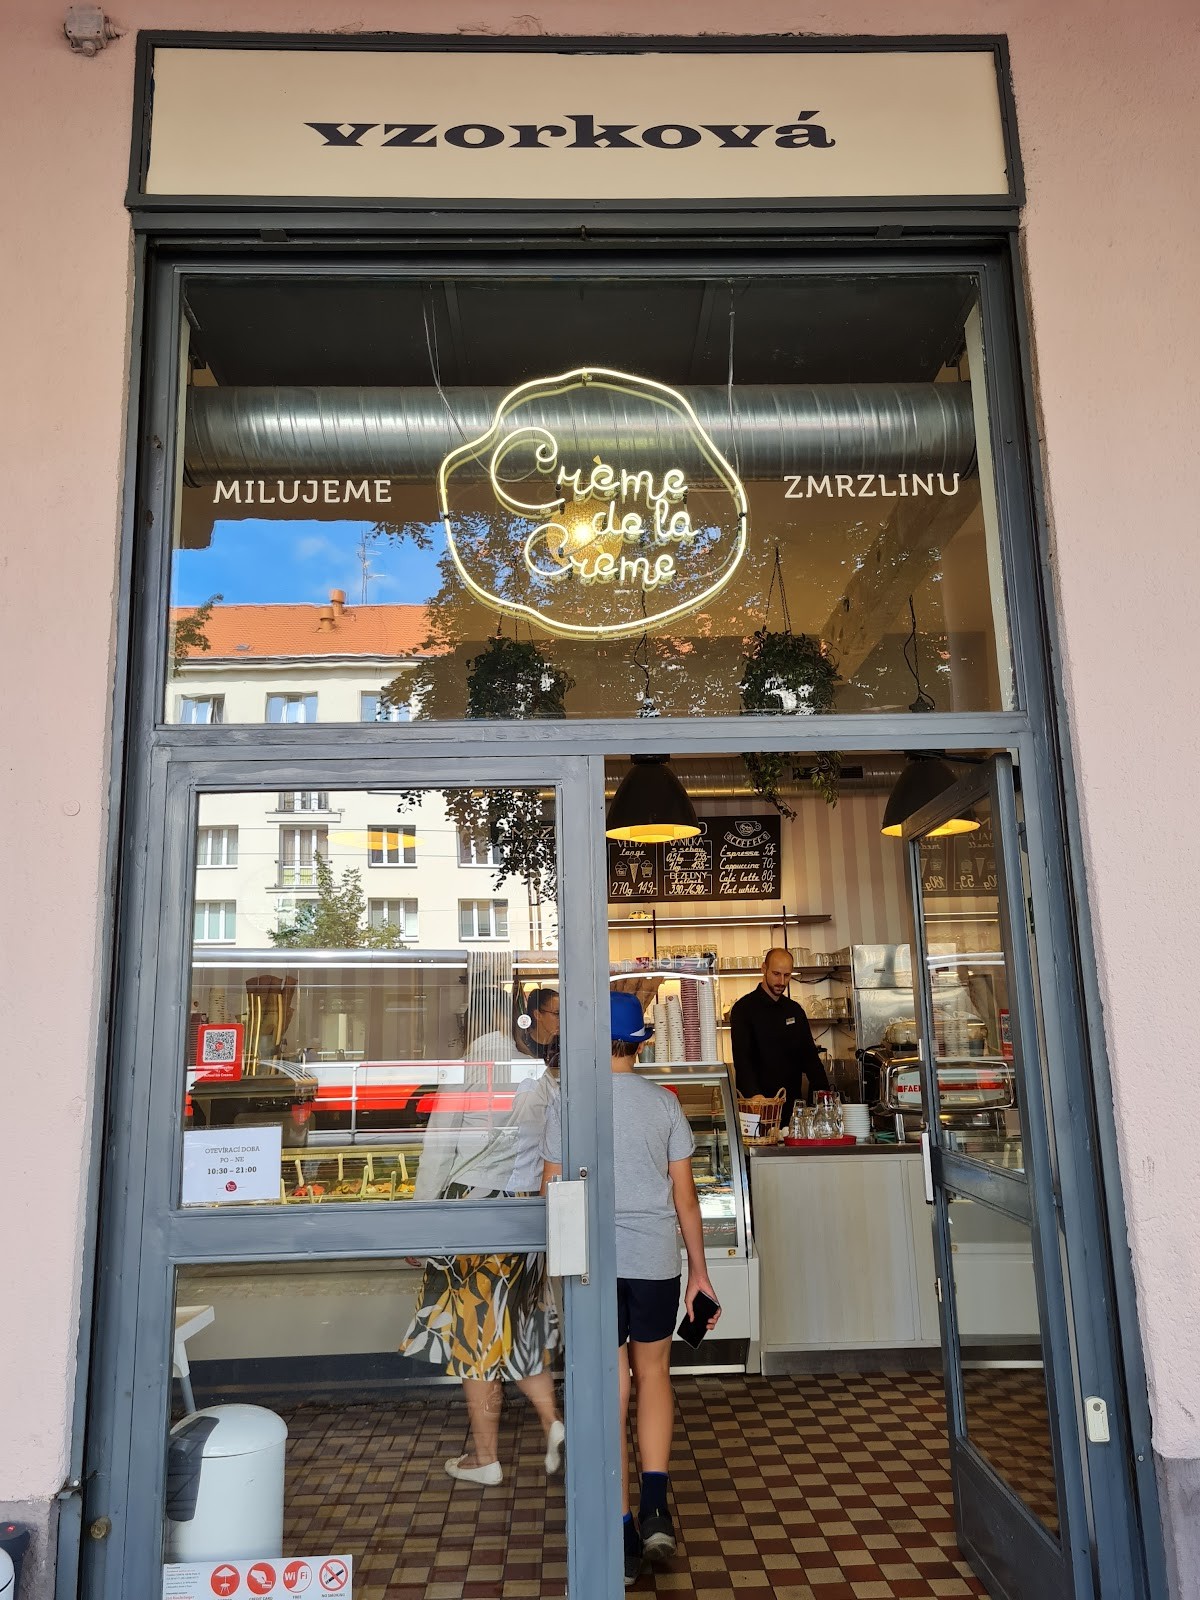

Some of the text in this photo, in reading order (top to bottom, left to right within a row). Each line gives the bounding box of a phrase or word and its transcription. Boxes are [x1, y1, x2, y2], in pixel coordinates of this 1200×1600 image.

[303, 110, 836, 149] vzorková
[213, 479, 392, 504] MILUJEME
[783, 472, 960, 499] ZMRZLINU
[592, 500, 699, 538] de la
[730, 836, 761, 848] COFFEE
[720, 844, 760, 859] Espresso
[720, 857, 760, 873] Cappuccino
[719, 871, 737, 886] Café
[740, 871, 760, 882] latte
[719, 882, 738, 894] Flat
[738, 884, 760, 894] white
